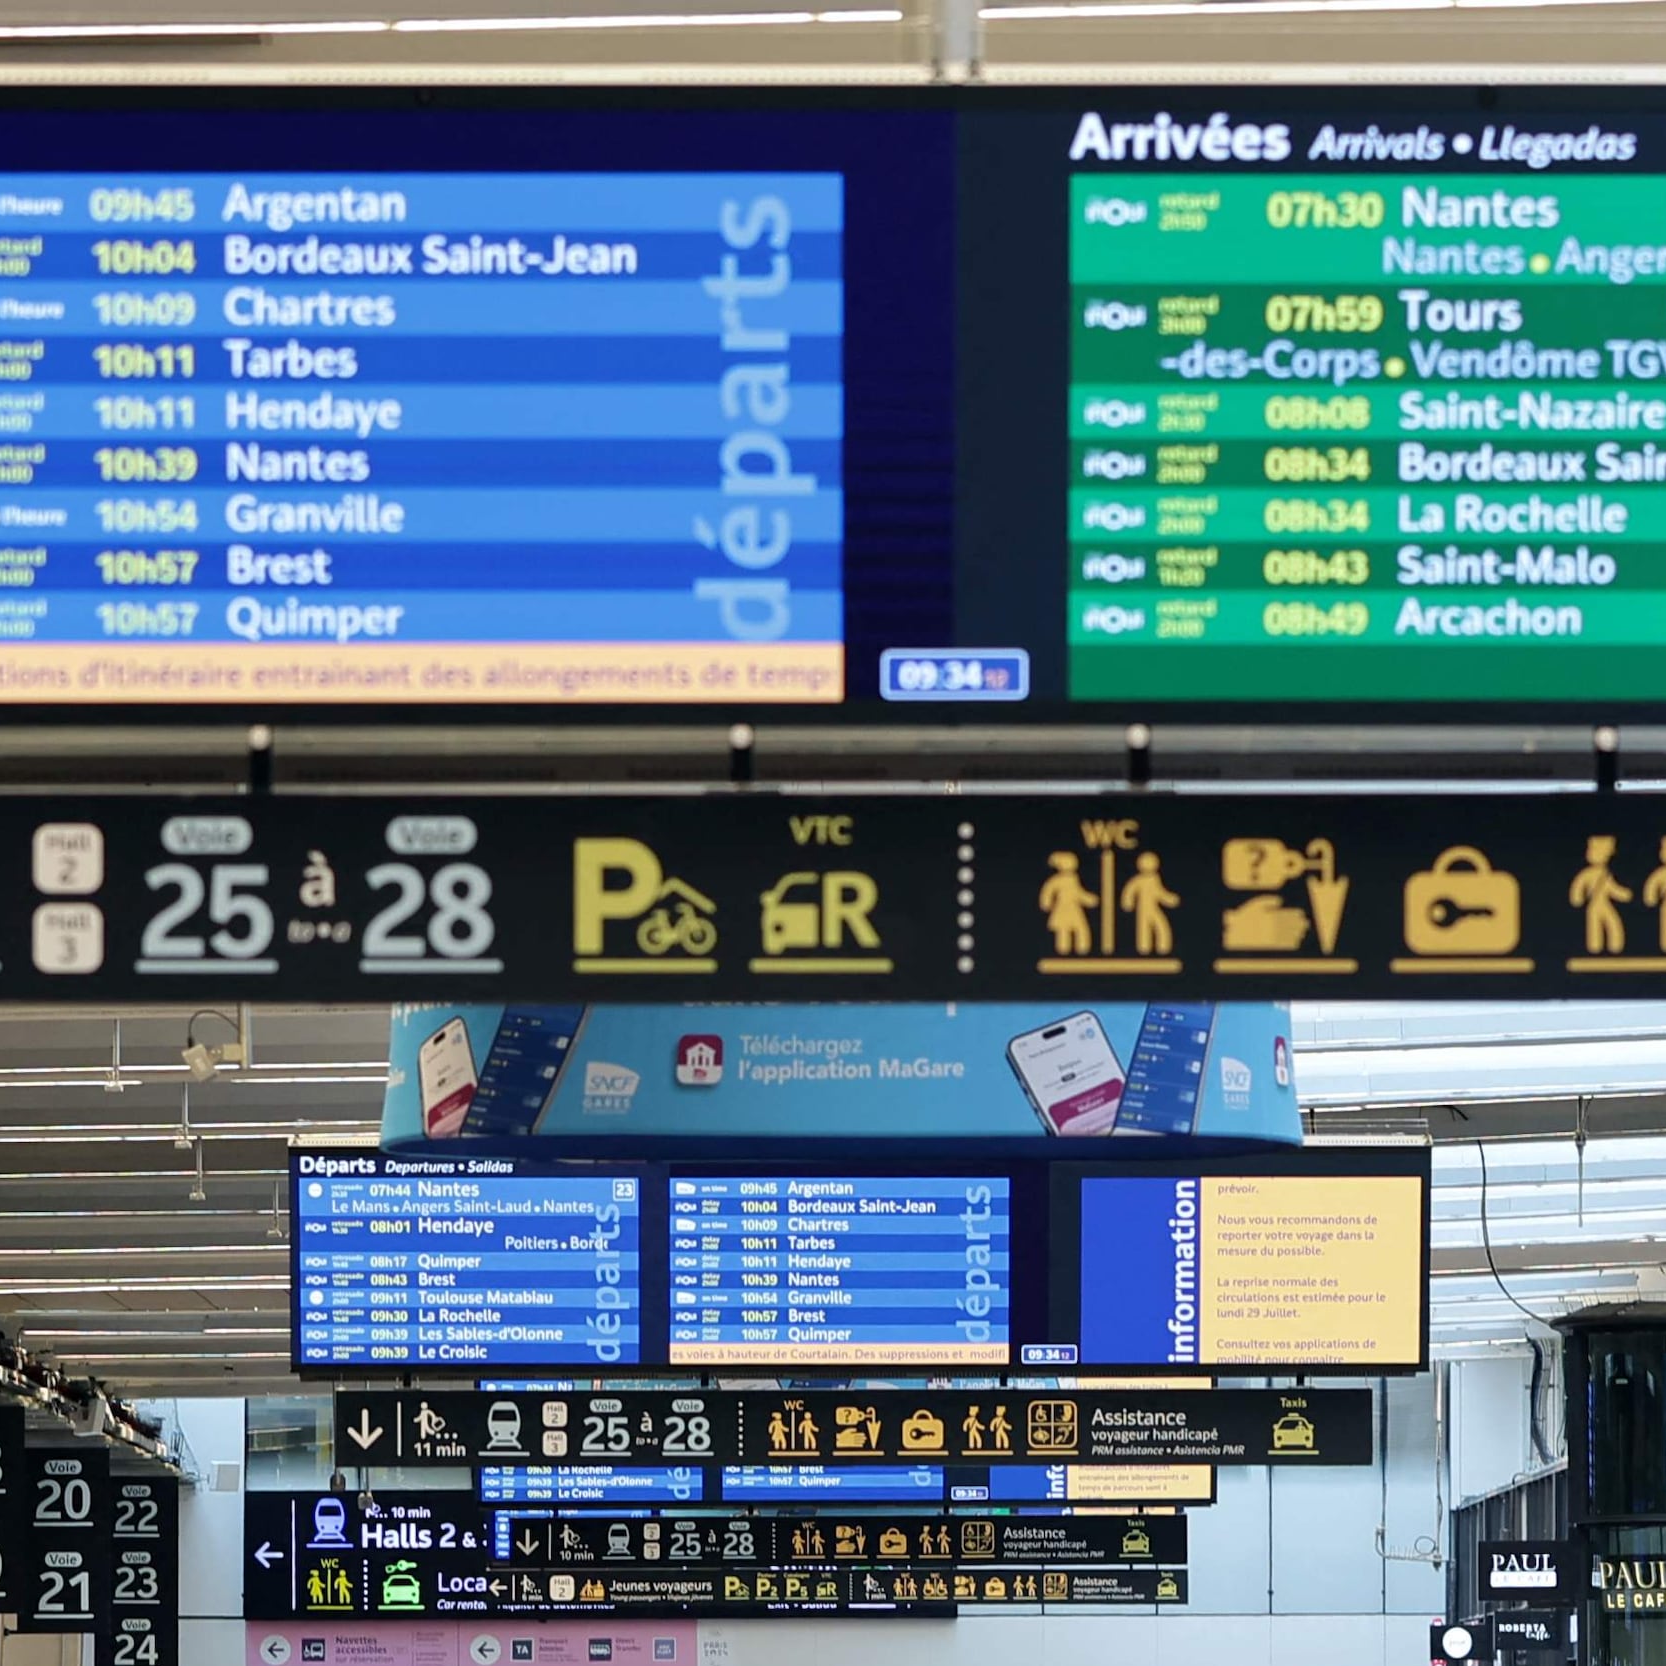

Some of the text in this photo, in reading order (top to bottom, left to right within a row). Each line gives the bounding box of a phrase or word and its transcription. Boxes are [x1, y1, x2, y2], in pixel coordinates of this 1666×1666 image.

[1069, 112, 1636, 169] Arrivées Arrivals Llegadas
[89, 183, 406, 231] 09h45 Argentan
[1266, 191, 1383, 228] 07h30
[1401, 186, 1559, 228] Nantes
[92, 235, 637, 275] 10h04 Bordeaux Saint-Jean
[1382, 238, 1524, 275] Nantes
[224, 287, 396, 326] Chartres
[1265, 290, 1521, 333] 07h59 Tours
[93, 339, 357, 378] 10h11 Tarbes
[1410, 338, 1601, 380] Vendôme
[1398, 443, 1586, 481] Bordeaux
[225, 494, 404, 532] Granville
[1398, 494, 1627, 533] La Rochelle
[1397, 545, 1616, 585] Saint-Malo
[96, 596, 404, 642] 10h57 Quimper
[1395, 597, 1581, 635] Arcachon
[898, 661, 983, 690] 09:34
[790, 815, 853, 846] VTC
[1081, 820, 1138, 849] WC
[142, 852, 495, 959] 25 à 28
[740, 1034, 862, 1060] Téléchargez
[739, 1058, 964, 1083] l'application MaGare
[299, 1156, 513, 1177] Départs Departures Salidas
[788, 1181, 853, 1198] Argentan
[1217, 1231, 1261, 1243] reporter
[1264, 1232, 1293, 1241] votre
[1296, 1232, 1333, 1243] voyage
[1336, 1230, 1362, 1241] dans
[1168, 1180, 1196, 1363] information
[1091, 1408, 1186, 1426] Assistance
[1281, 1397, 1307, 1408] Taxis
[414, 1441, 466, 1457] 11 min
[582, 1411, 711, 1452] 25 à 28
[1091, 1428, 1218, 1444] voyageur handicapé
[35, 1478, 91, 1521] 20
[115, 1500, 158, 1533] 22
[362, 1523, 432, 1549] Halls
[439, 1523, 456, 1549] 2
[321, 1558, 339, 1569] WC
[1492, 1554, 1556, 1571] PAUL
[38, 1571, 90, 1613] 21
[115, 1566, 158, 1600] 23
[610, 1580, 712, 1594] Jeunes voyageurs
[1607, 1593, 1625, 1609] LE
[113, 1634, 158, 1666] 24
